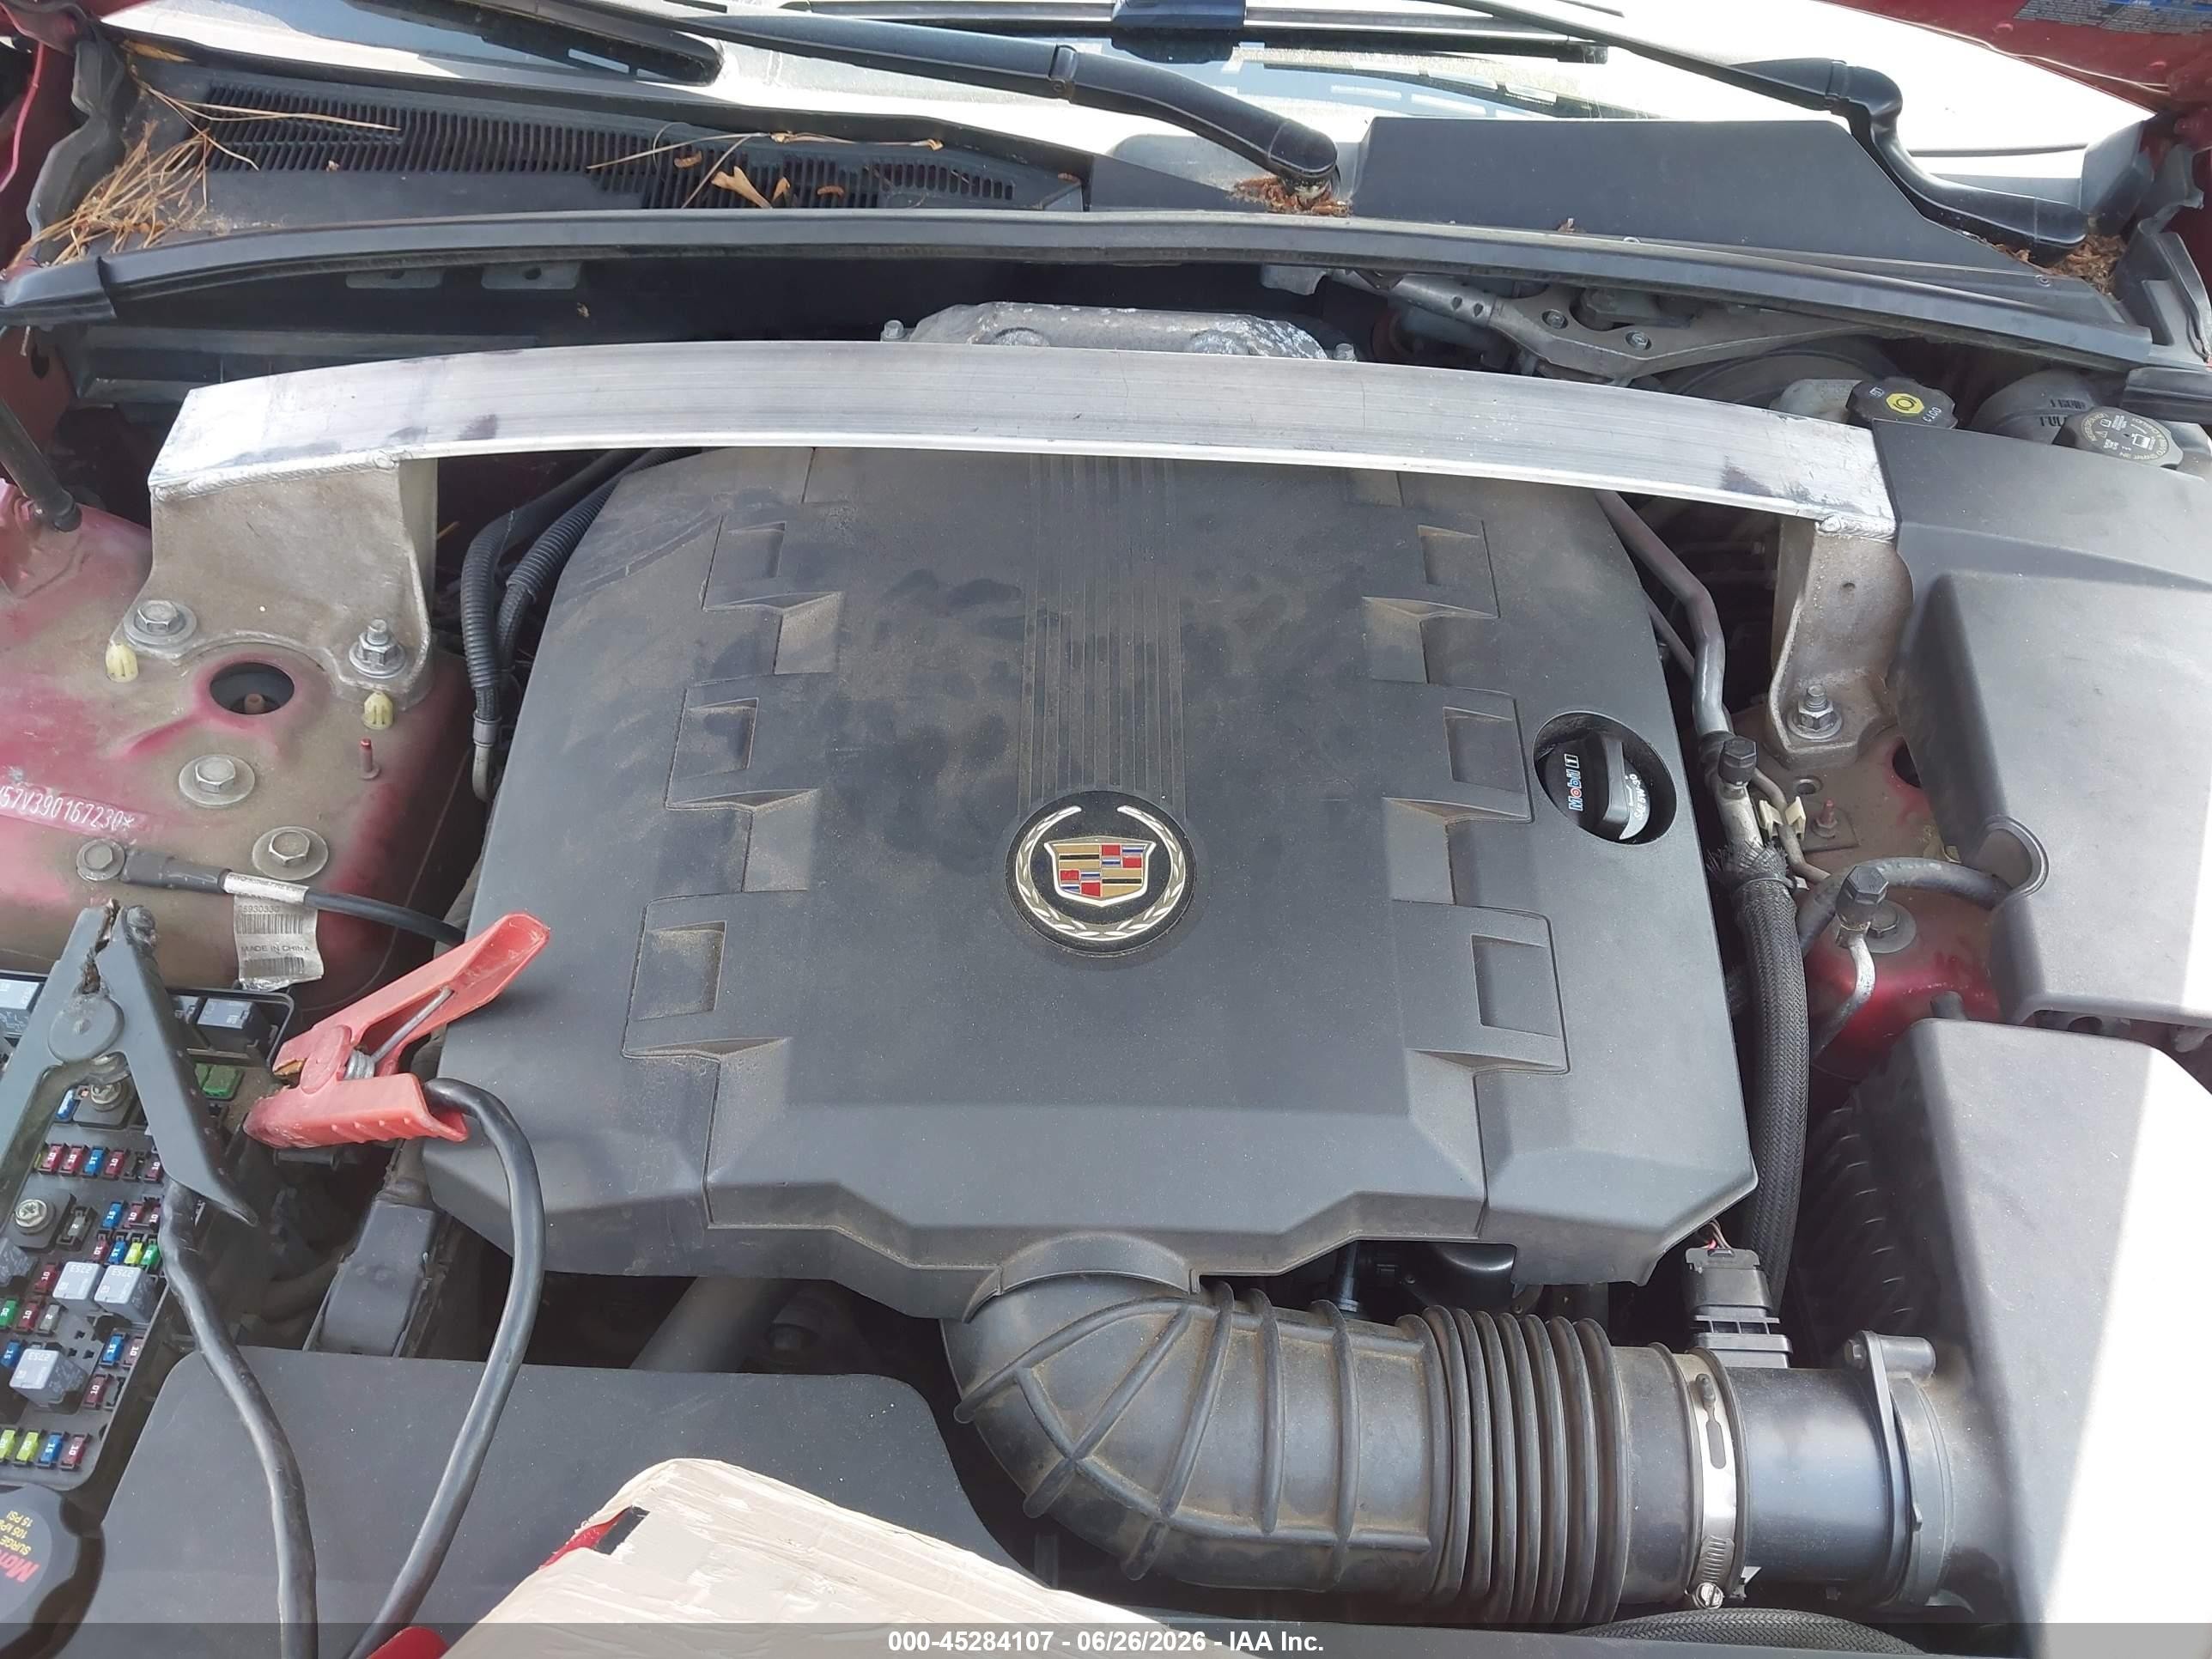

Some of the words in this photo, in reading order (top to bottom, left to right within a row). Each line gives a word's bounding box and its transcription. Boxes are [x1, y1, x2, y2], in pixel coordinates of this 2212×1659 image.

[1565, 754, 1580, 769] 1
[1565, 769, 1584, 811] Mobil
[1633, 802, 1647, 820] SAE
[6, 1510, 24, 1523] PSI
[21, 1516, 33, 1528] 15
